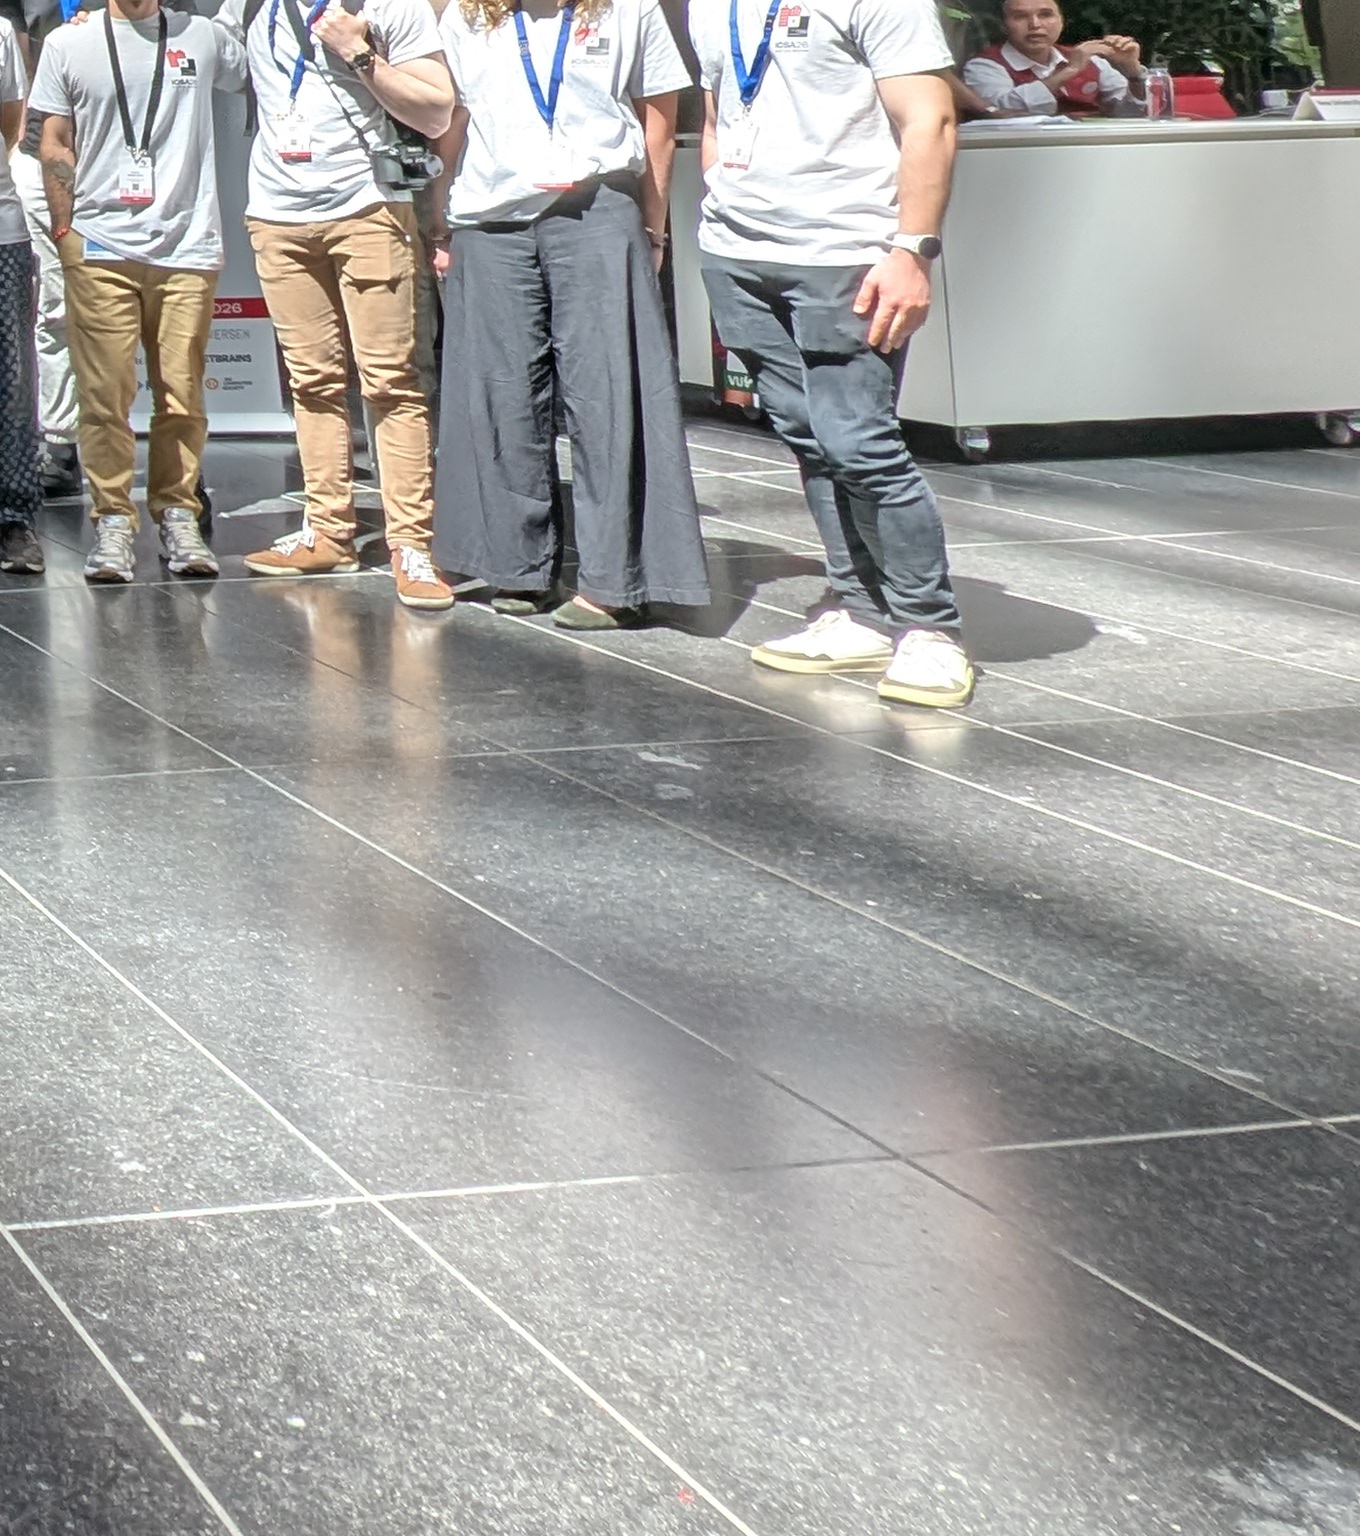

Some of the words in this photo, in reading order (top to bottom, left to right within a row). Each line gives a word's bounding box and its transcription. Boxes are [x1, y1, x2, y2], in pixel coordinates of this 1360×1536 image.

[213, 302, 243, 314] 026
[211, 328, 251, 341] ERSEN
[204, 353, 252, 363] ETBRAINS
